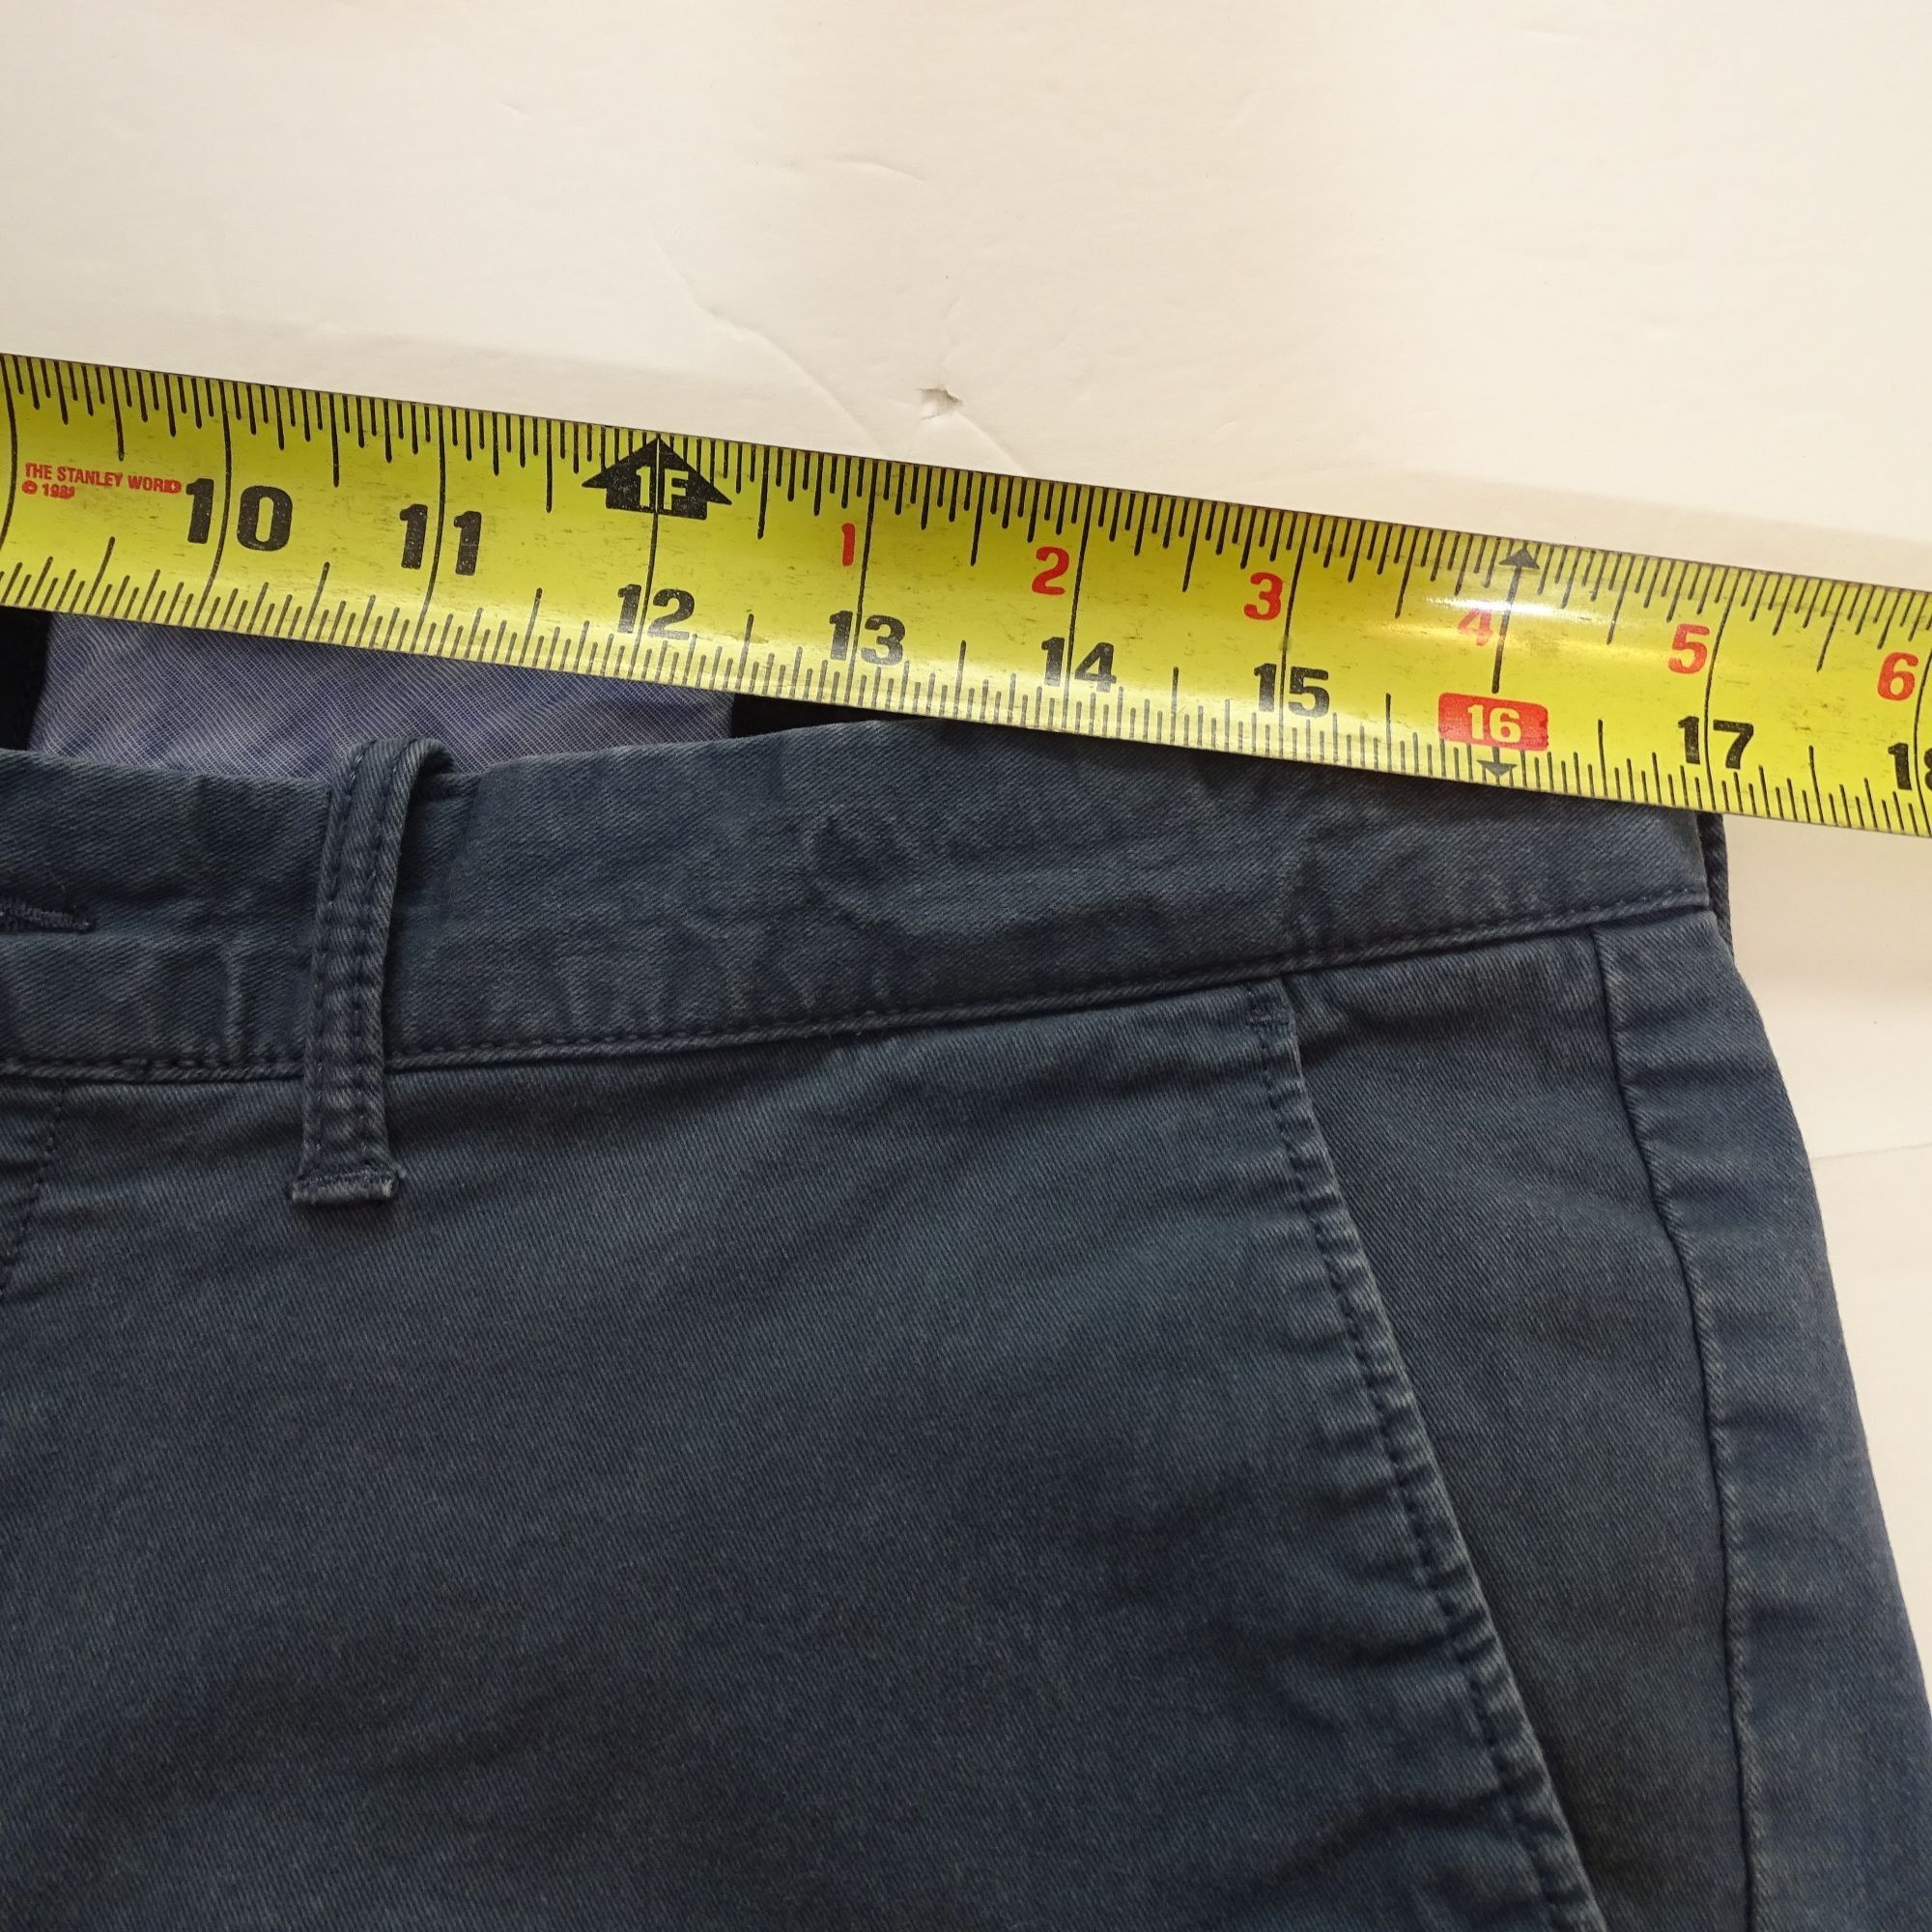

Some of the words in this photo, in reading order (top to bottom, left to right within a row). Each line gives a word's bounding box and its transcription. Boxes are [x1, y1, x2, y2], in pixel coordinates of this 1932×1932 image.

[25, 462, 52, 480] THE
[57, 466, 124, 487] STANLEY
[185, 478, 293, 552] 10
[399, 503, 483, 576] 11
[841, 523, 856, 566] 1
[1031, 546, 1069, 595] 2
[617, 583, 696, 639] 12
[1243, 572, 1283, 621] 3
[829, 611, 905, 666] 13
[1457, 603, 1493, 646] 4
[1668, 623, 1709, 673] 5
[1041, 637, 1117, 693] 14
[1877, 652, 1918, 700] 6
[1254, 663, 1330, 718] 15
[1467, 703, 1521, 744] 16
[1678, 716, 1754, 770] 17
[1888, 742, 1932, 792] 1
